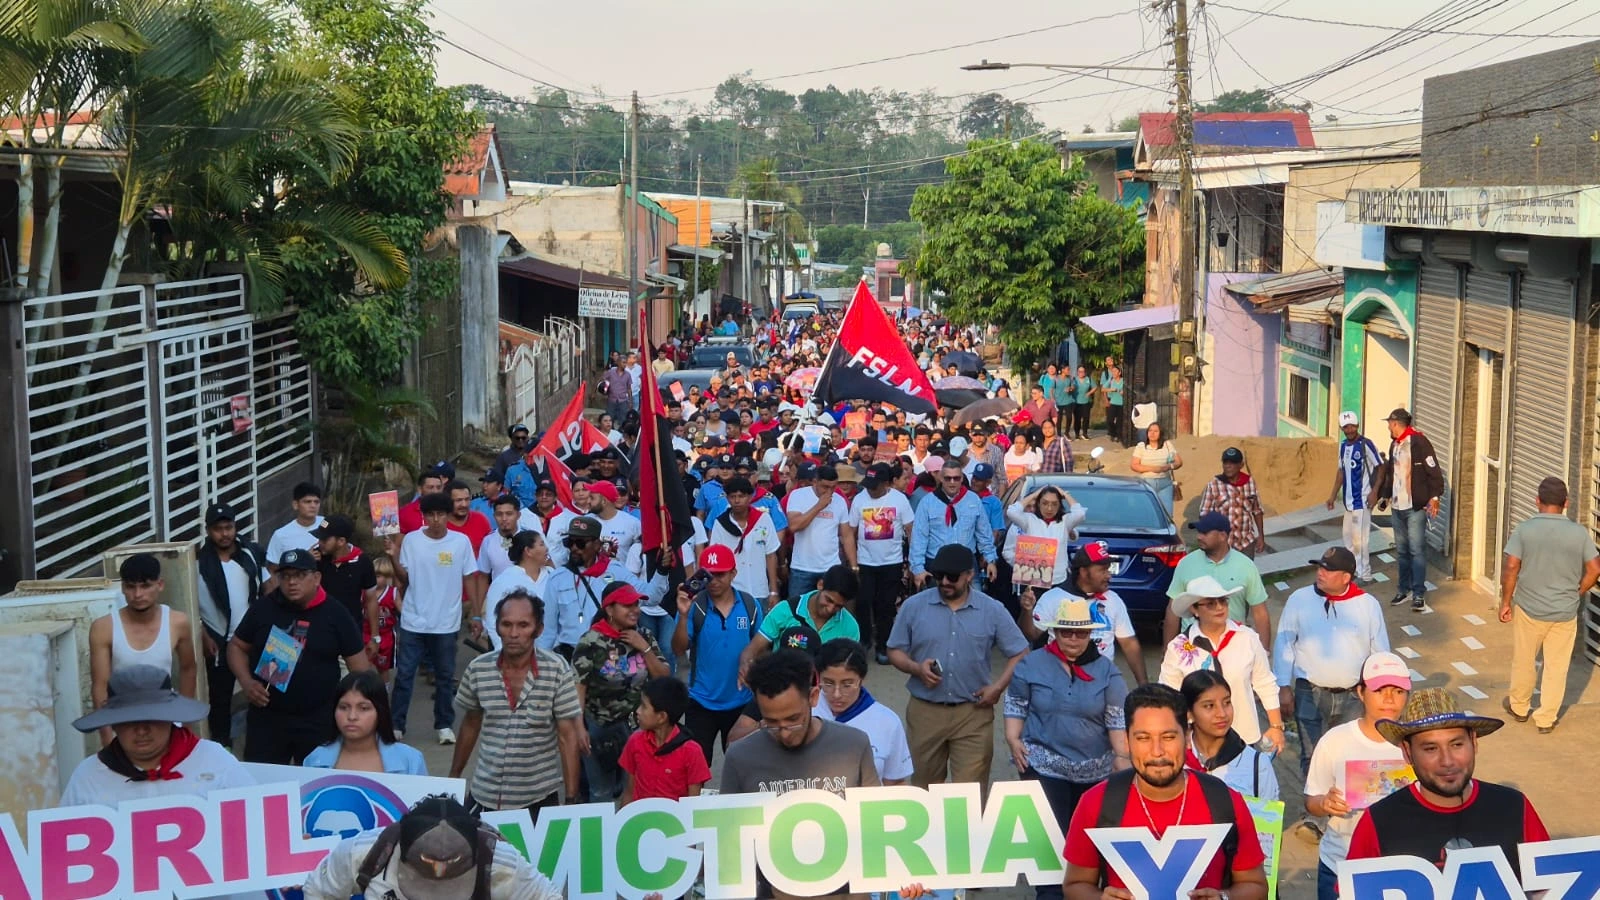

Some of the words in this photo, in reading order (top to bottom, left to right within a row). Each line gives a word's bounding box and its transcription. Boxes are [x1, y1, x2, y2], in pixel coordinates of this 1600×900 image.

[1358, 190, 1402, 223] VARIEDADES
[1406, 190, 1448, 226] GENARITA
[580, 289, 602, 297] Oficina
[603, 290, 609, 298] de
[846, 346, 923, 396] FSLN
[708, 552, 718, 565] NY
[759, 776, 847, 795] AMERICAN
[497, 795, 1064, 894] VICTORIA
[1111, 839, 1207, 900] Y
